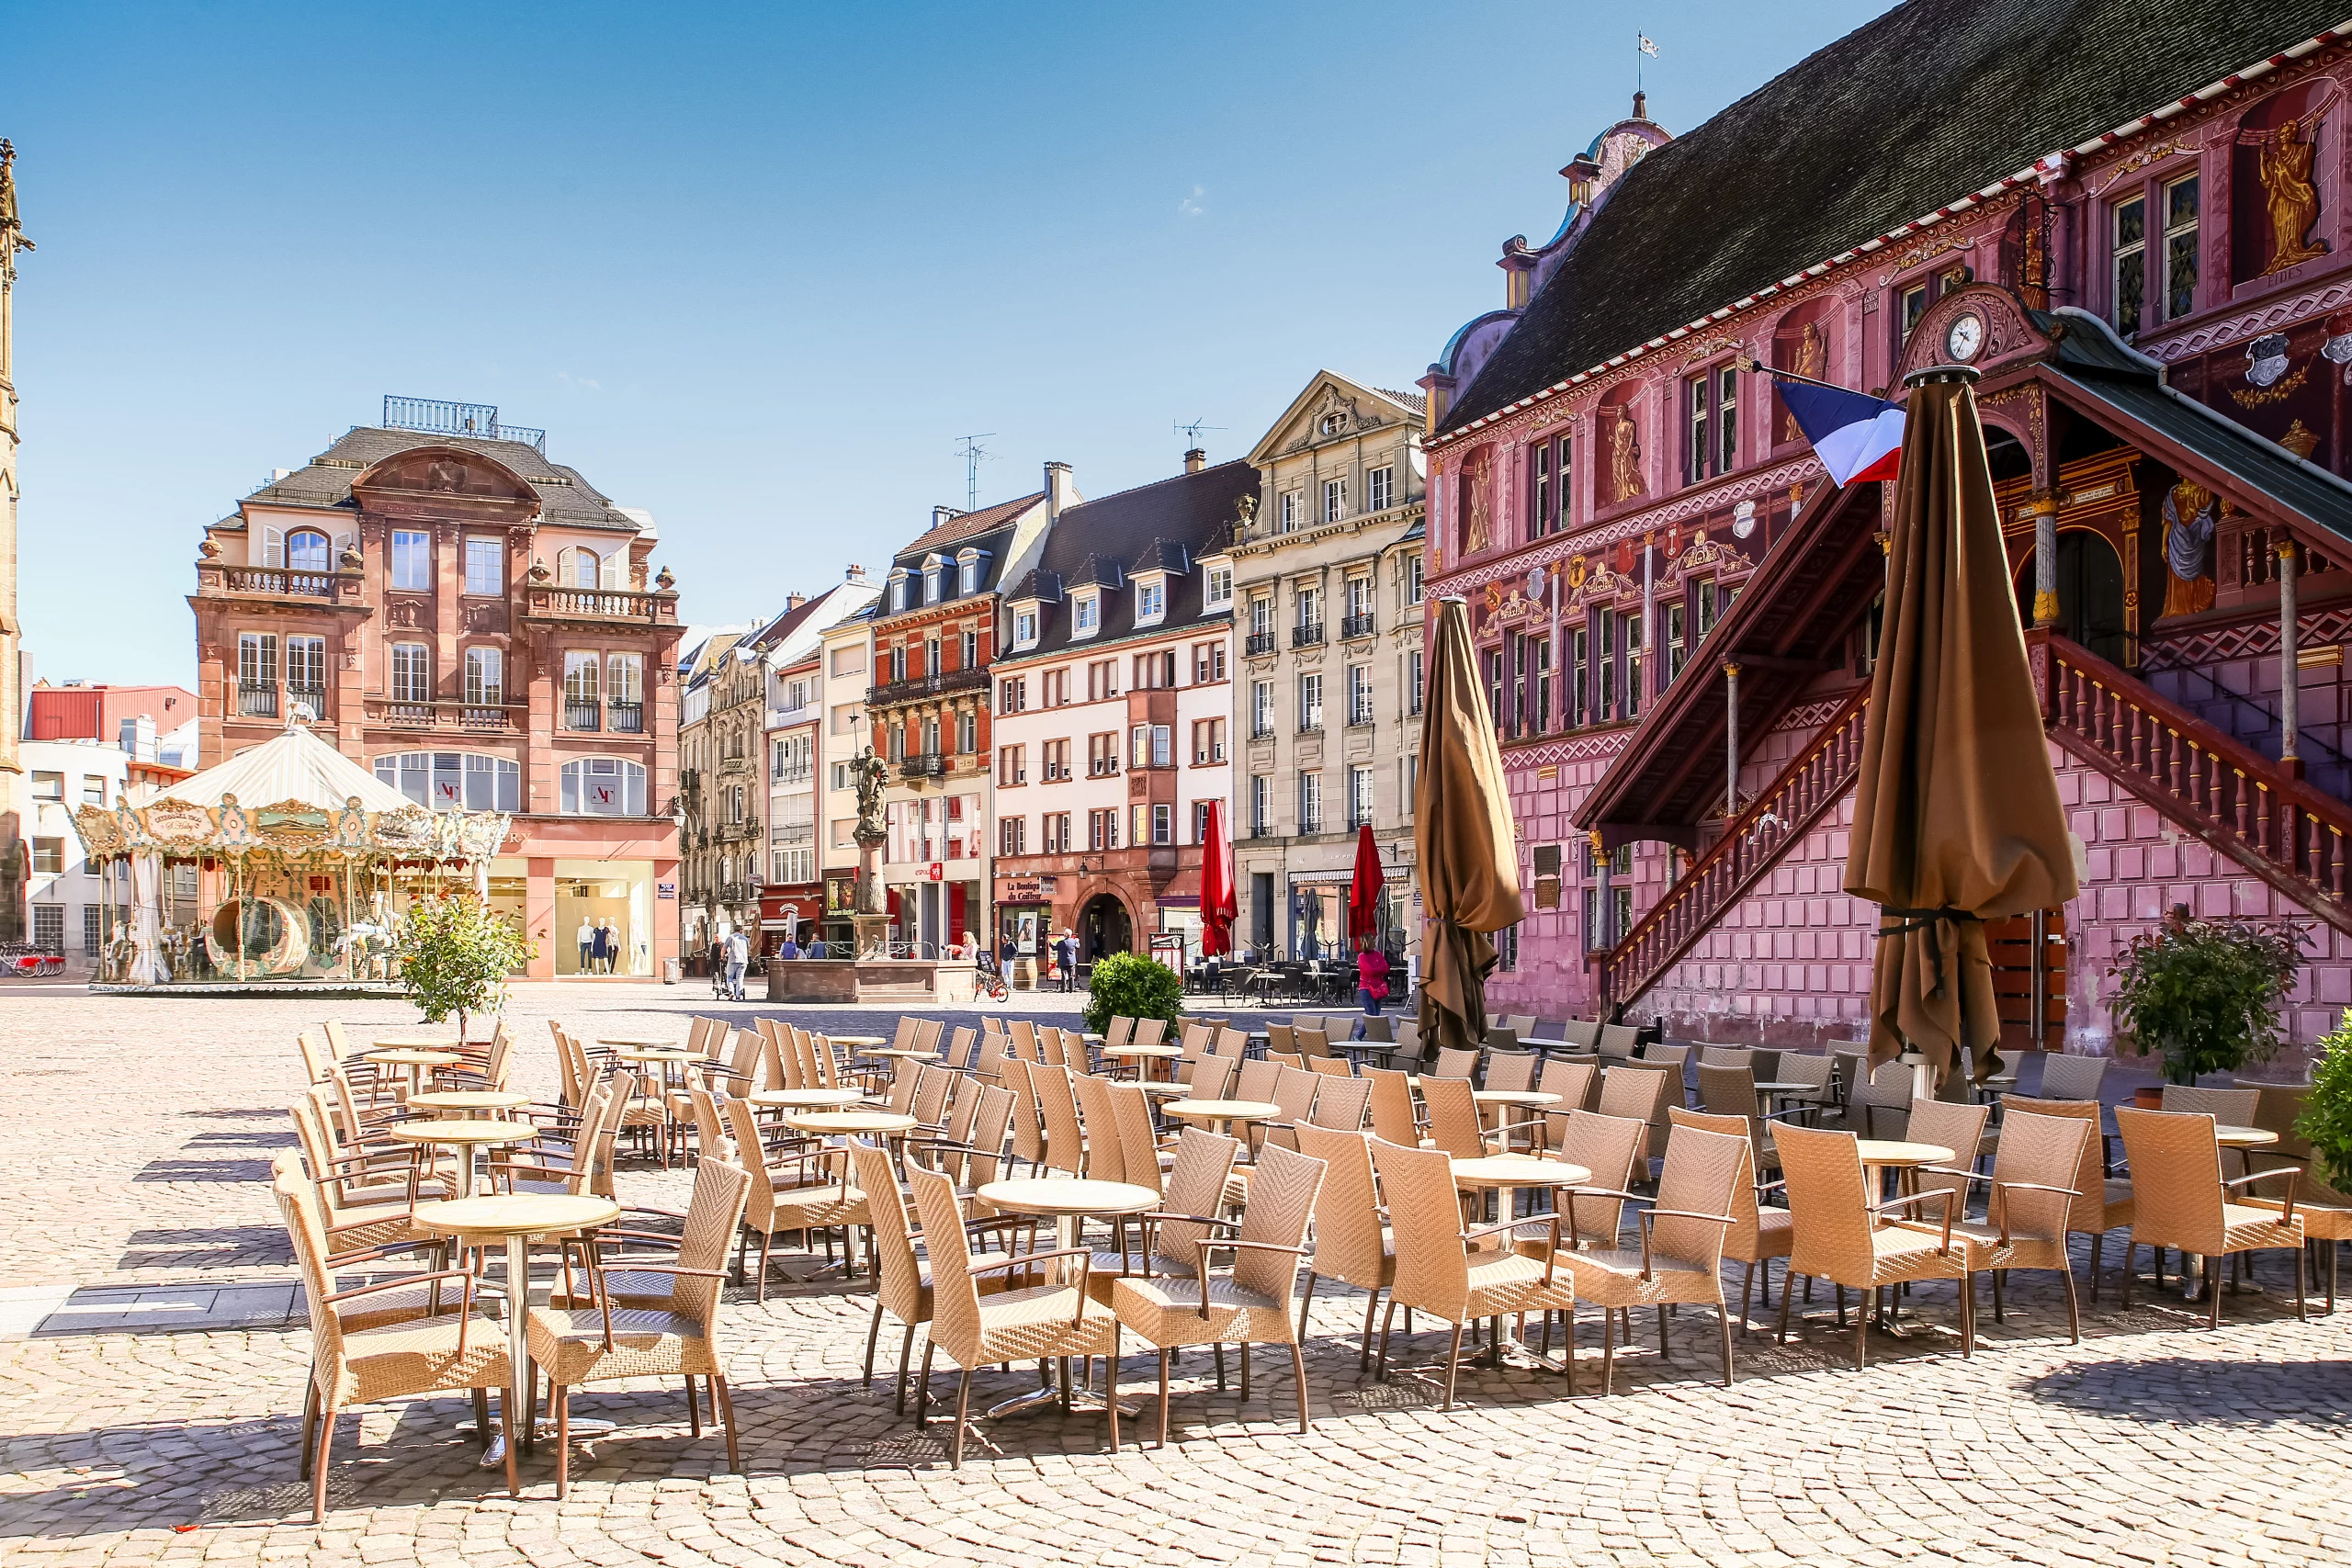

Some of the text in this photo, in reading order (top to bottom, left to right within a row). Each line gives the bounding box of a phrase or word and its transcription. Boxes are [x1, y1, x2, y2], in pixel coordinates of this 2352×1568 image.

[2267, 264, 2302, 288] FIDES
[1793, 437, 1808, 448] JVST
[1007, 882, 1014, 891] La
[1016, 881, 1040, 892] Boutiqu
[1008, 891, 1041, 900] du Coiffeur
